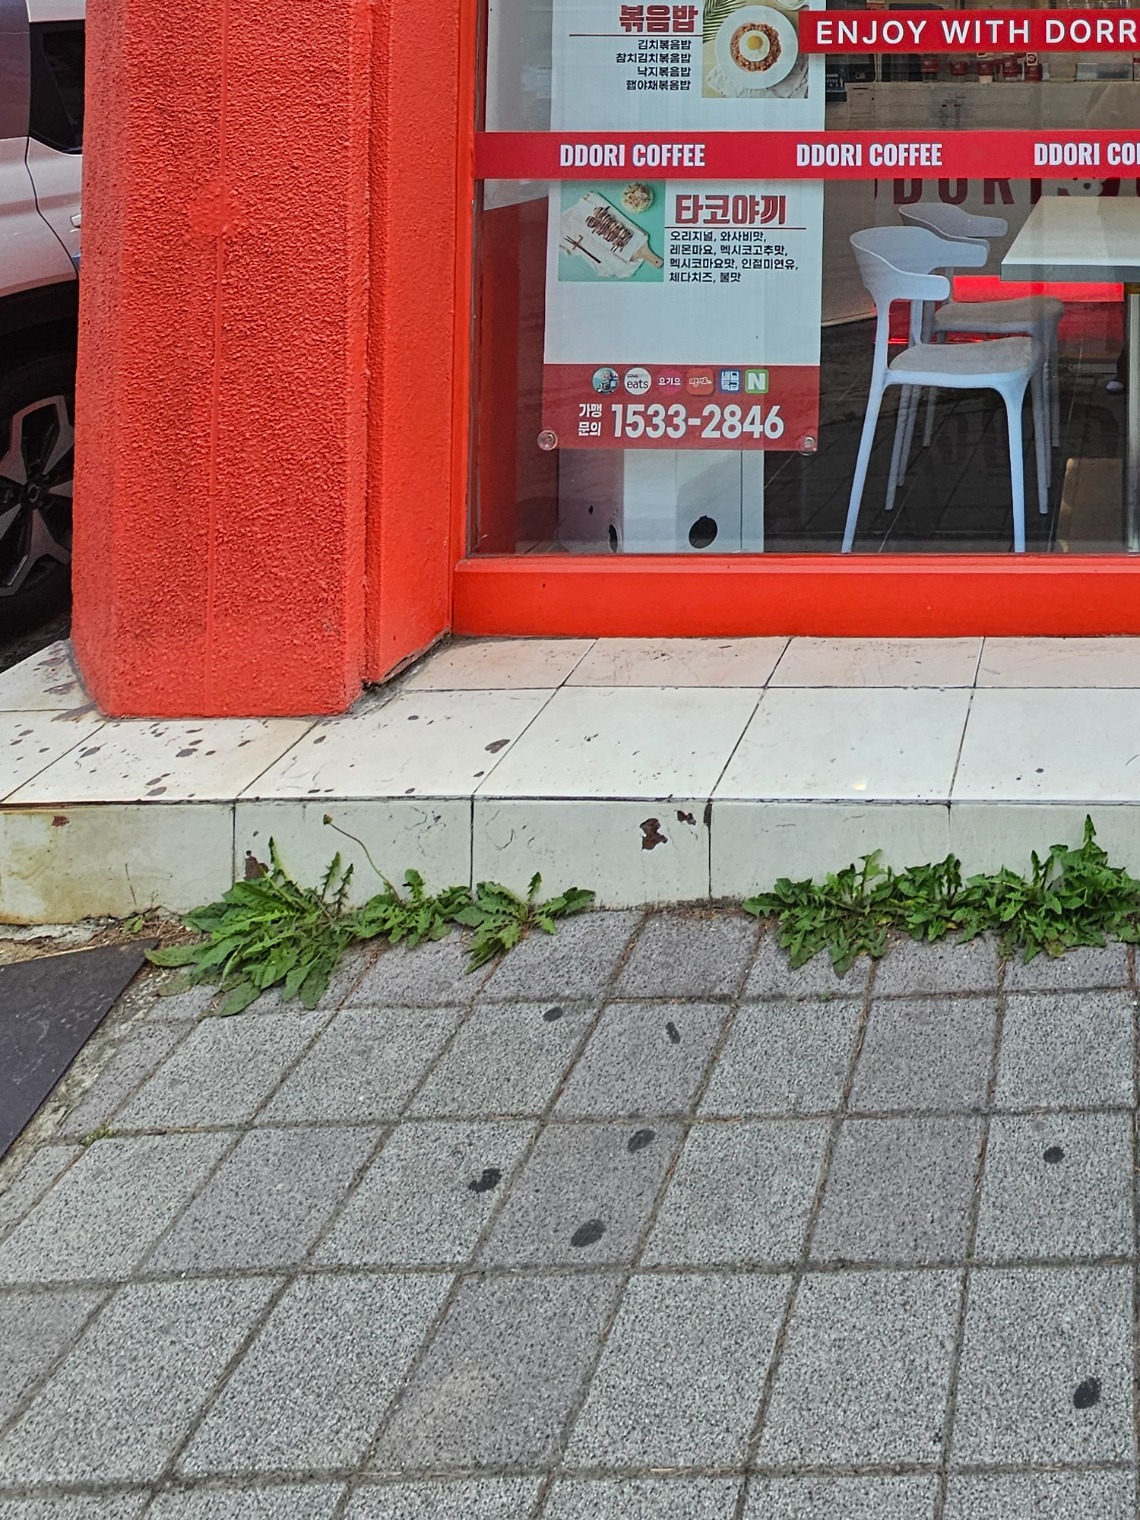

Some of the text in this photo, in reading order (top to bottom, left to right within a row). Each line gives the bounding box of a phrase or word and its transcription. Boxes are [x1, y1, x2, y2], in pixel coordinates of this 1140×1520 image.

[618, 4, 699, 33] 볶음밥
[816, 20, 927, 45] ENJOY
[941, 19, 1031, 44] WITH
[637, 39, 692, 51] 김치볶음밥
[615, 52, 692, 64] 참치김치볶음밥
[636, 66, 692, 78] 낙지볶음밥
[560, 143, 706, 167] DDORI COFFEE
[796, 143, 943, 167] DDORI COFFEE
[1033, 142, 1100, 166] DDORI
[674, 194, 787, 225] 타코야끼
[670, 230, 767, 243] 오리지널, 와사비맛,
[669, 244, 789, 257] 레몬마요, 멕시코고추맛,
[669, 258, 799, 271] 멕시코마요맛, 인절미연유,
[669, 271, 717, 284] 체다치즈,
[626, 379, 649, 389] eats
[578, 403, 785, 439] 가맹 1533-2846
[577, 421, 602, 437] 문의
